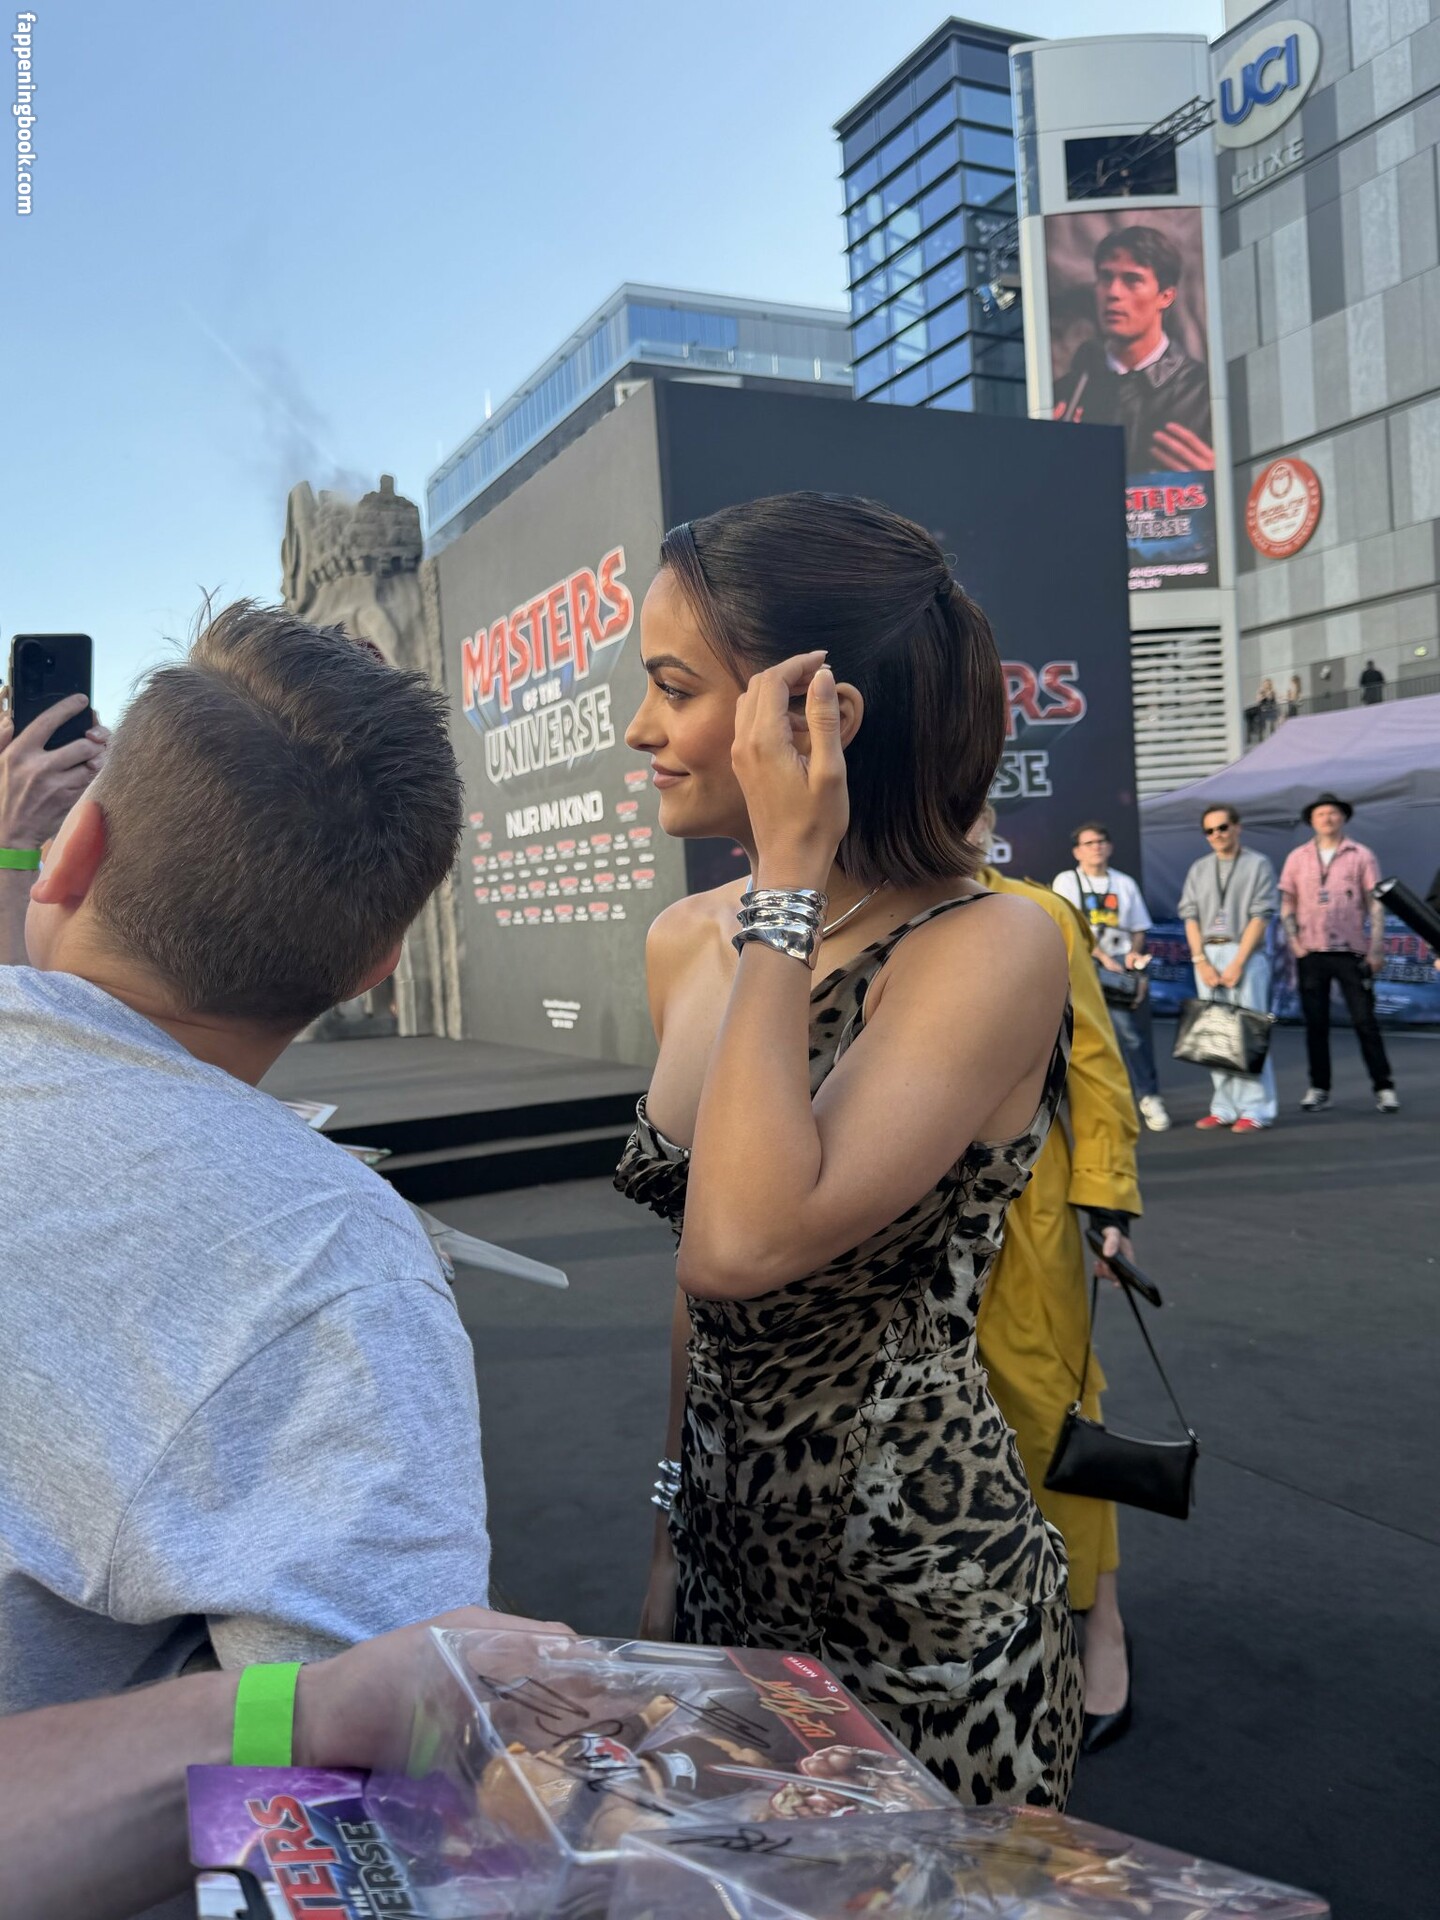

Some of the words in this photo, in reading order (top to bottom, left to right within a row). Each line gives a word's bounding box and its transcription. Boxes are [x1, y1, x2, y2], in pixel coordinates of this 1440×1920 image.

[1220, 33, 1300, 127] UCI
[1232, 137, 1304, 196] LUXE
[1125, 484, 1208, 517] TERS
[461, 545, 634, 713] MASTERS
[484, 683, 616, 785] UNIVERSE
[505, 805, 540, 839] NUR
[540, 800, 560, 832] IM
[560, 790, 604, 828] KINO
[337, 1820, 419, 1920] ERSE
